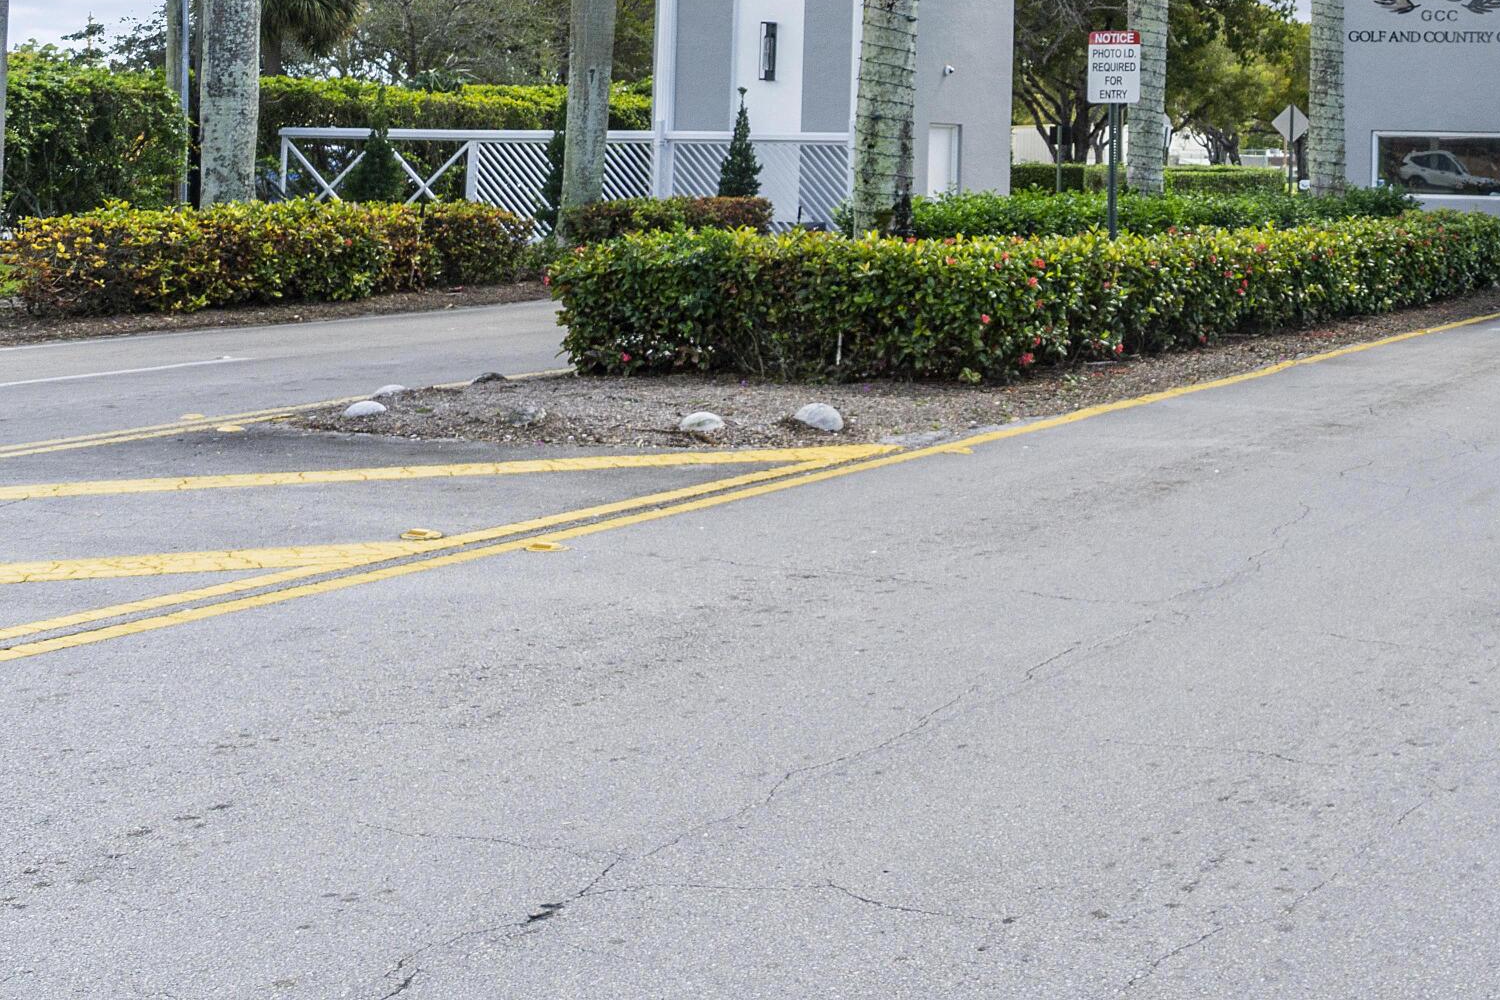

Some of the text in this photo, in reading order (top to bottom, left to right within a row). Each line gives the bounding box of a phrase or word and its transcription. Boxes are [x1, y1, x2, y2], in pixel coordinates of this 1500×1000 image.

[1421, 10, 1458, 22] GCC
[1095, 33, 1135, 43] NOTICE
[1348, 31, 1387, 43] GOLF
[1388, 31, 1421, 43] AND
[1424, 31, 1494, 43] COUNTRY
[1092, 48, 1122, 58] PHOTO
[1092, 62, 1136, 72] REQUIRED
[1104, 76, 1122, 85] FOR
[1099, 89, 1128, 99] ENTRY
